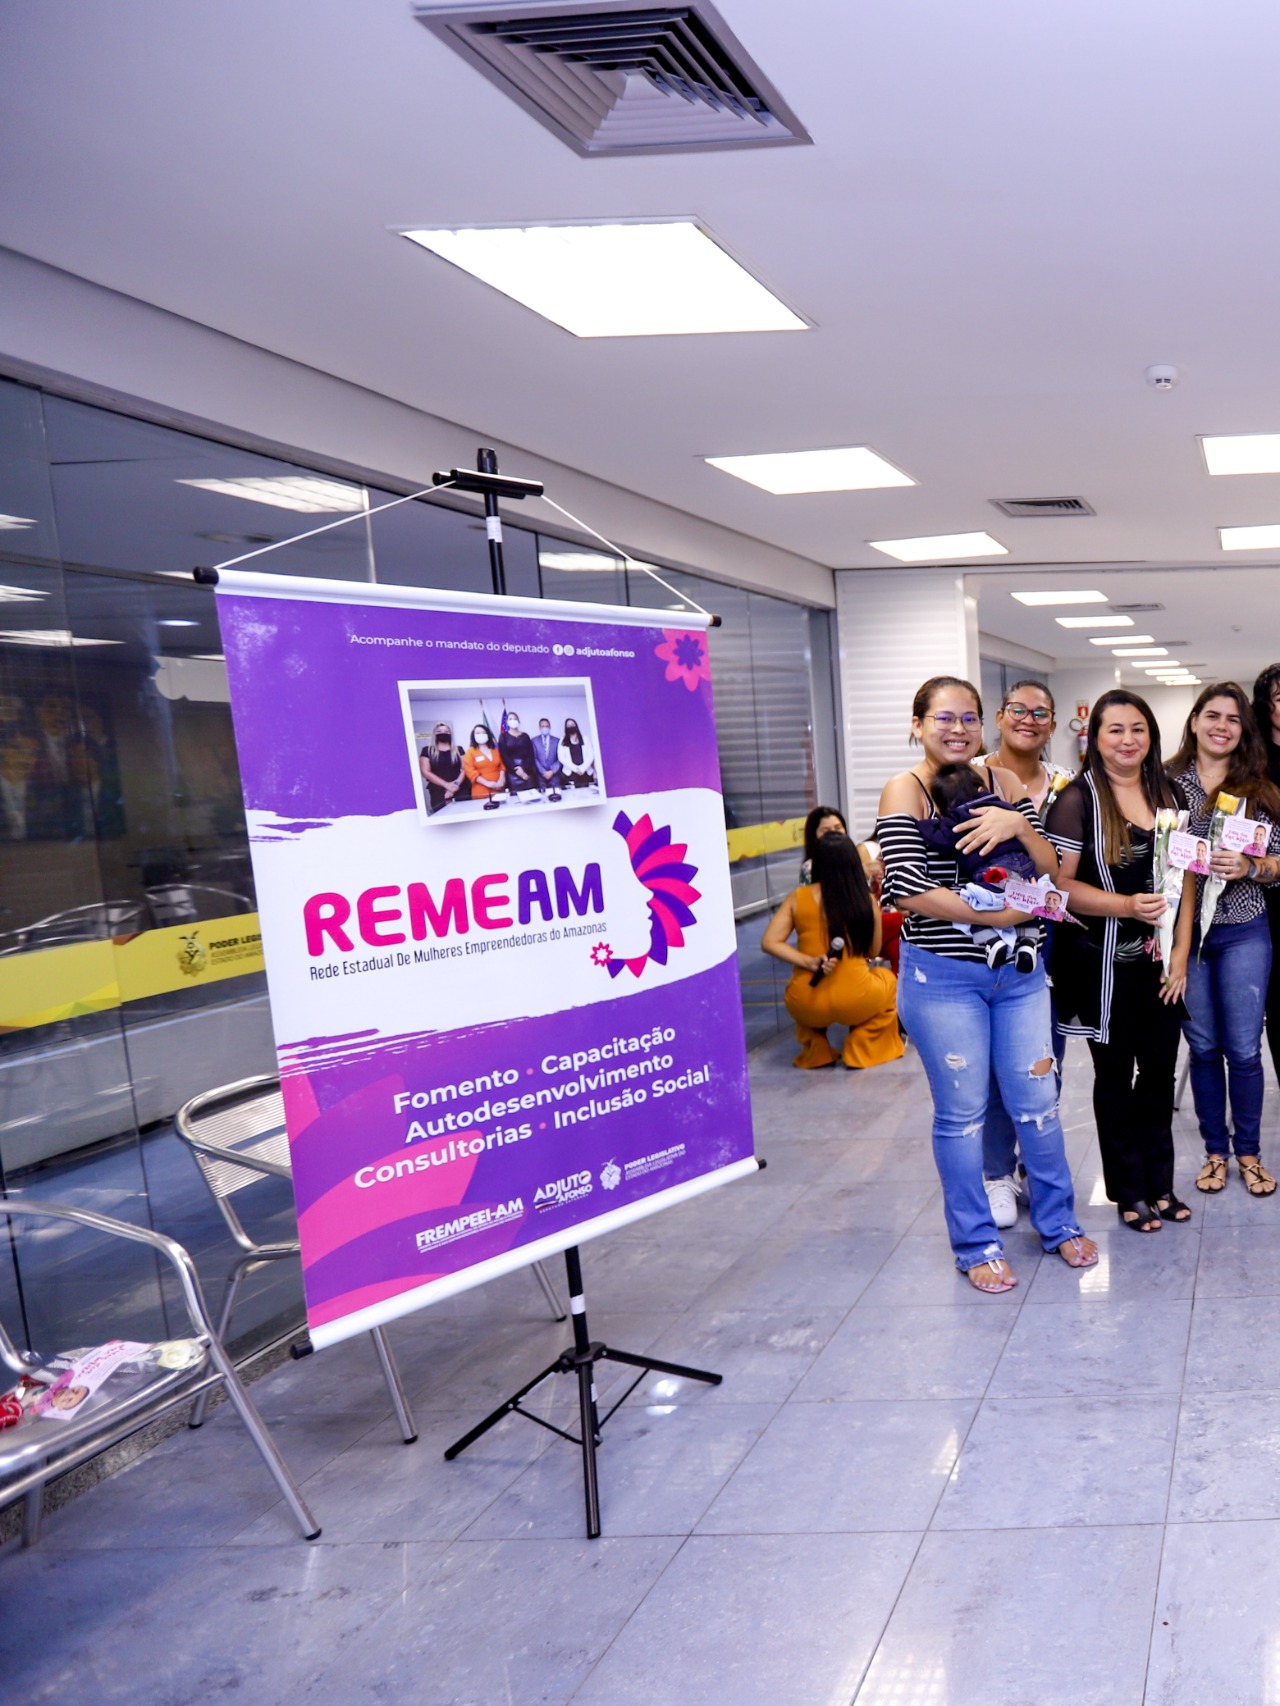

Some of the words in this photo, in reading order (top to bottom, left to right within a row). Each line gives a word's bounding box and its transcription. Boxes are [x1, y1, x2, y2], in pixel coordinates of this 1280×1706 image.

[350, 634, 423, 647] Acompanhe
[426, 639, 433, 648] o
[436, 640, 484, 650] mandato
[486, 641, 500, 651] do
[502, 642, 549, 653] deputado
[576, 646, 635, 658] adjutoafonso
[303, 862, 604, 957] REMEAM
[209, 937, 239, 950] PODER
[310, 963, 340, 981] Rede
[343, 954, 394, 975] Estadual
[397, 952, 411, 966] De
[413, 945, 463, 963] Mulheres
[465, 932, 548, 955] Empreendedoras
[550, 928, 561, 941] do
[563, 922, 607, 938] Amazonas
[393, 1068, 519, 1115] Fomento
[541, 1025, 676, 1075] Capacitação
[405, 1054, 674, 1143] Autodesenvolvimento
[354, 1123, 533, 1189] Consultorias
[553, 1087, 648, 1129] Inclusão
[651, 1064, 710, 1098] Social
[533, 1170, 592, 1203] ADJUTO
[416, 1197, 524, 1247] FREMPEEI-AM
